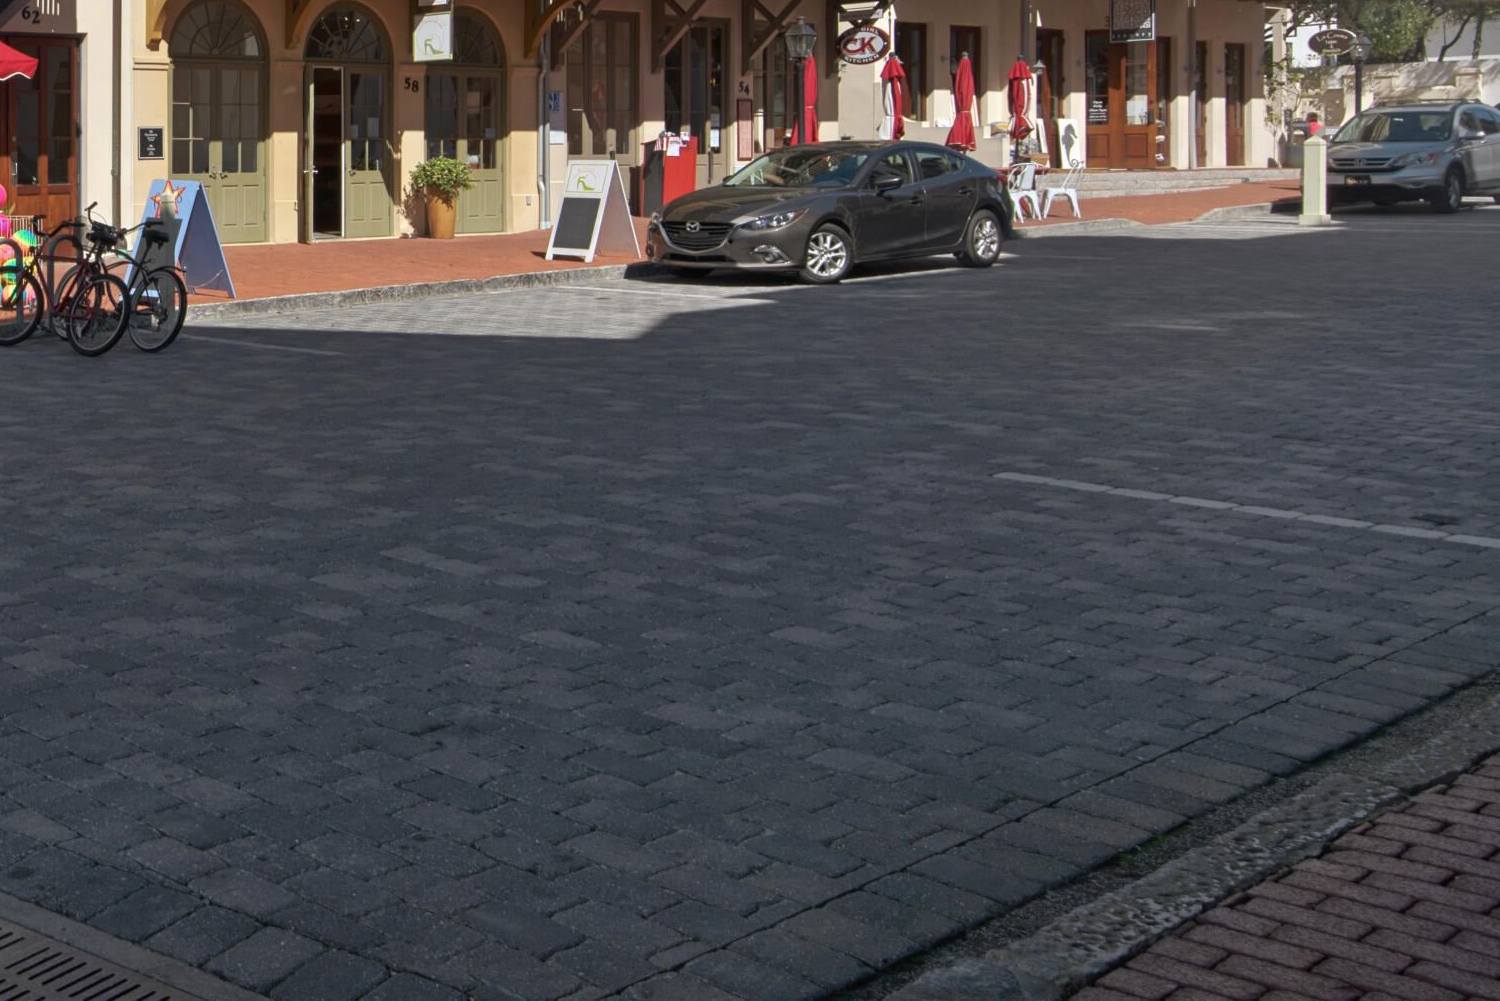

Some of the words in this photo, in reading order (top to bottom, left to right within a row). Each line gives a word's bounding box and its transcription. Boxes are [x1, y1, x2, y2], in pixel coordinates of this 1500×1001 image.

[21, 5, 41, 24] 62
[844, 53, 880, 64] KITCHEN
[404, 76, 420, 93] 58
[738, 80, 750, 96] 54
